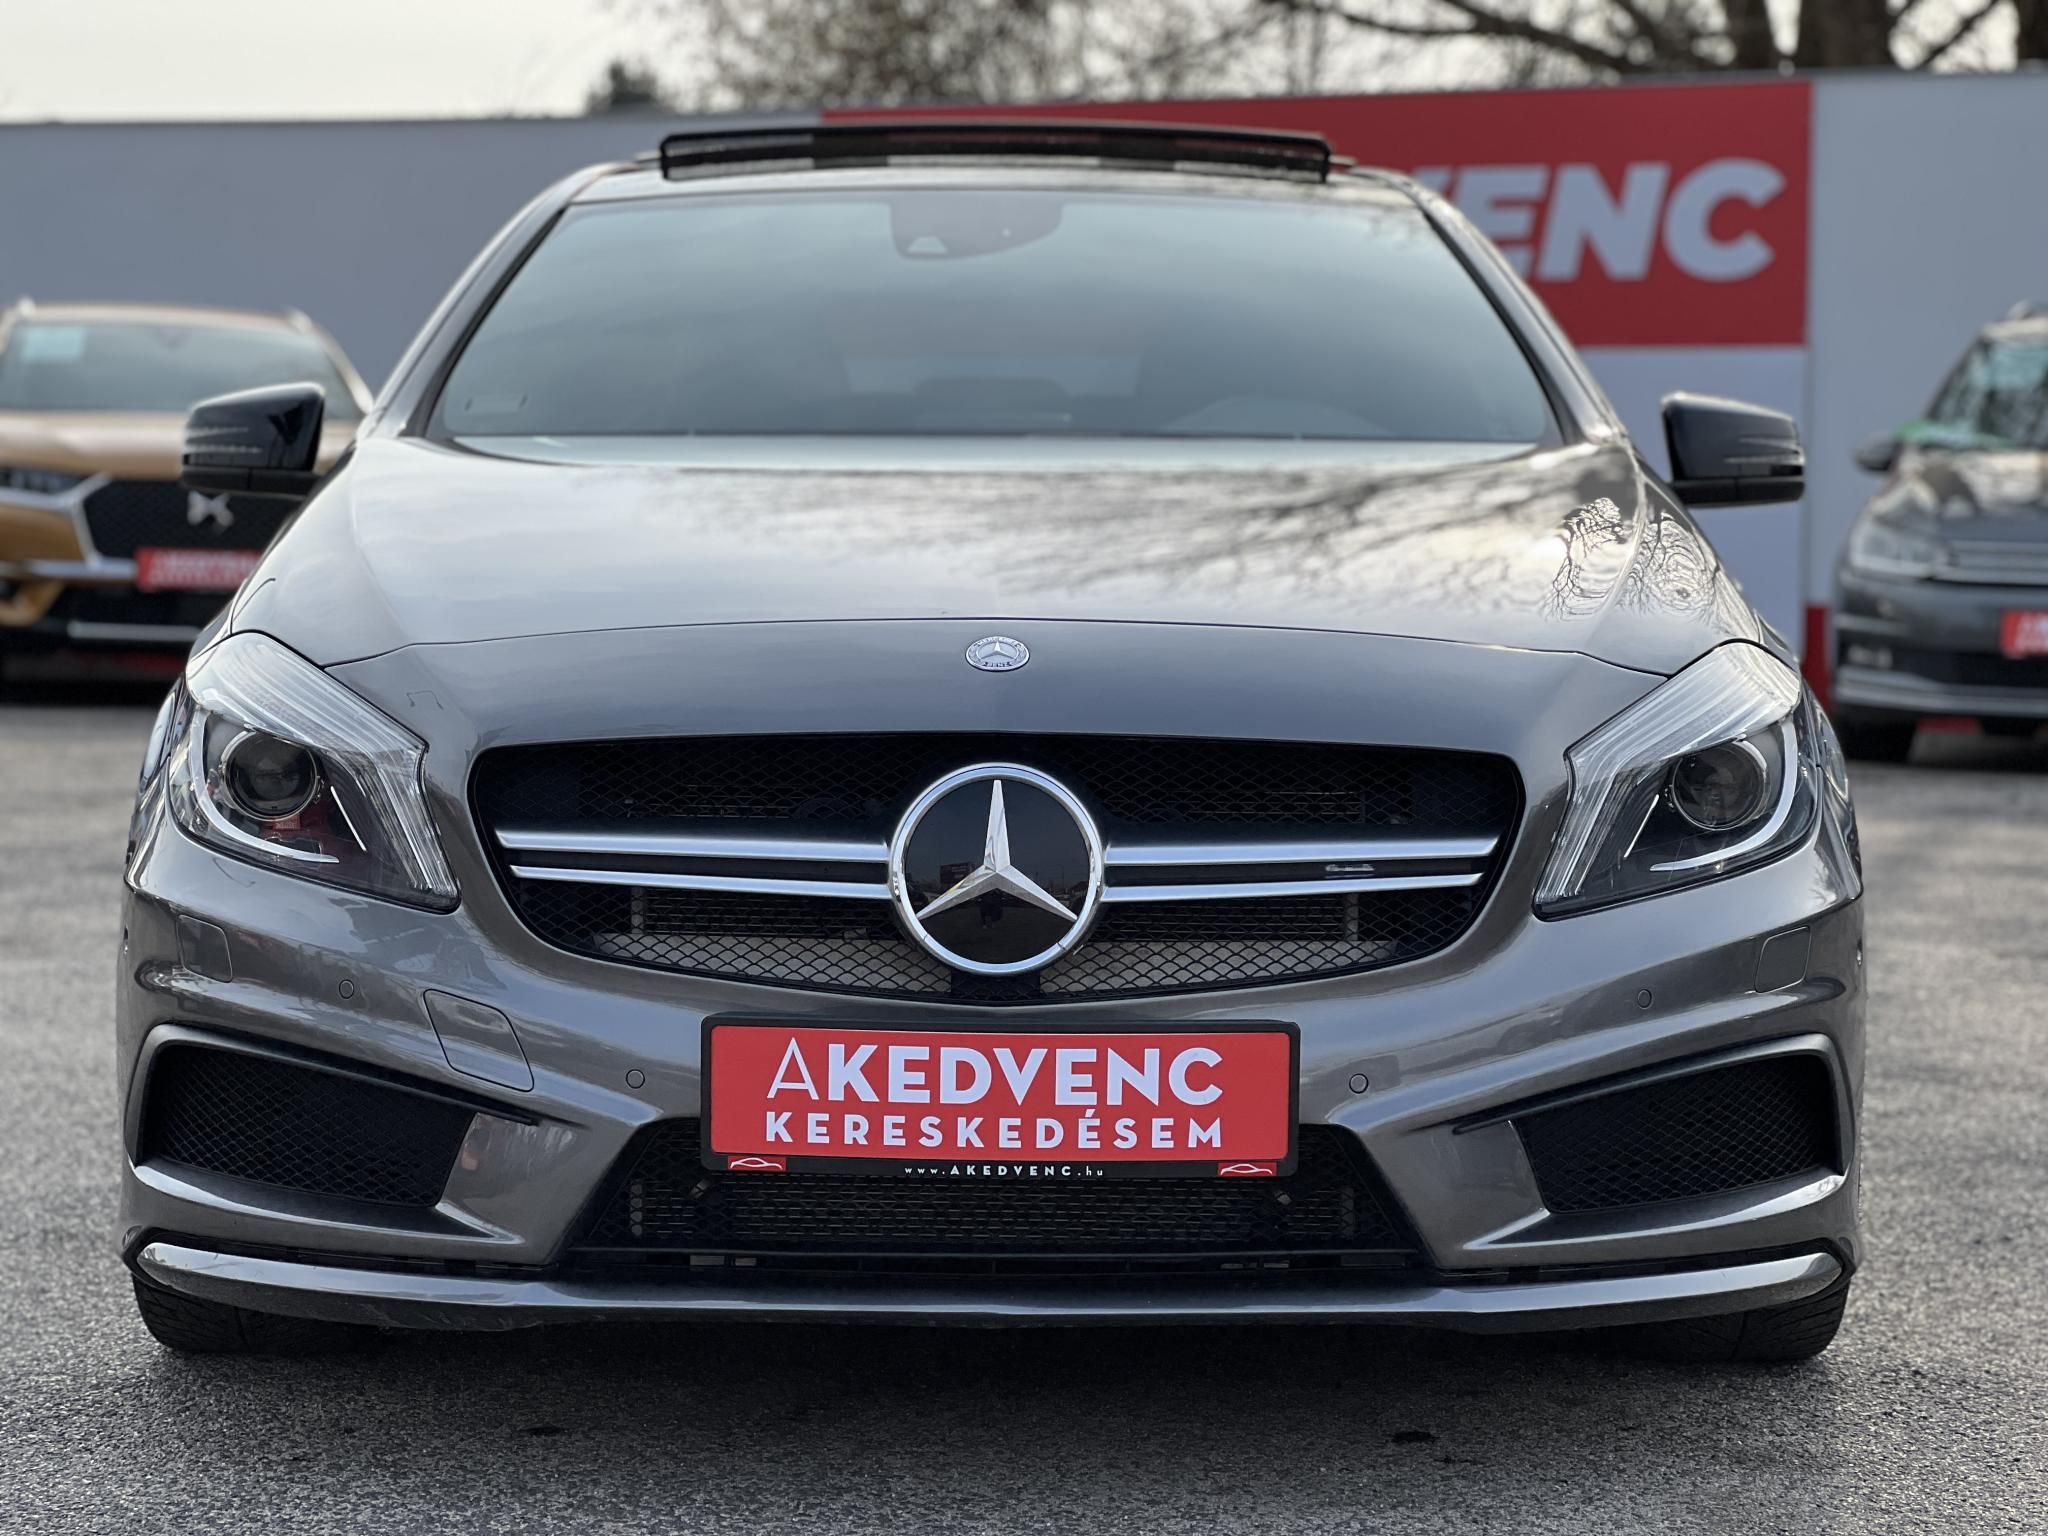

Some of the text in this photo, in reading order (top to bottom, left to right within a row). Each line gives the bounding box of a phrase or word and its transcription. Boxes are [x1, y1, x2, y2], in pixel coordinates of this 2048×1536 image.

[767, 1037, 1223, 1107] AKEDVENC
[766, 1109, 1221, 1149] KERESKEDÉSEM
[904, 1164, 1104, 1177] www.AKEDVENC.hu
